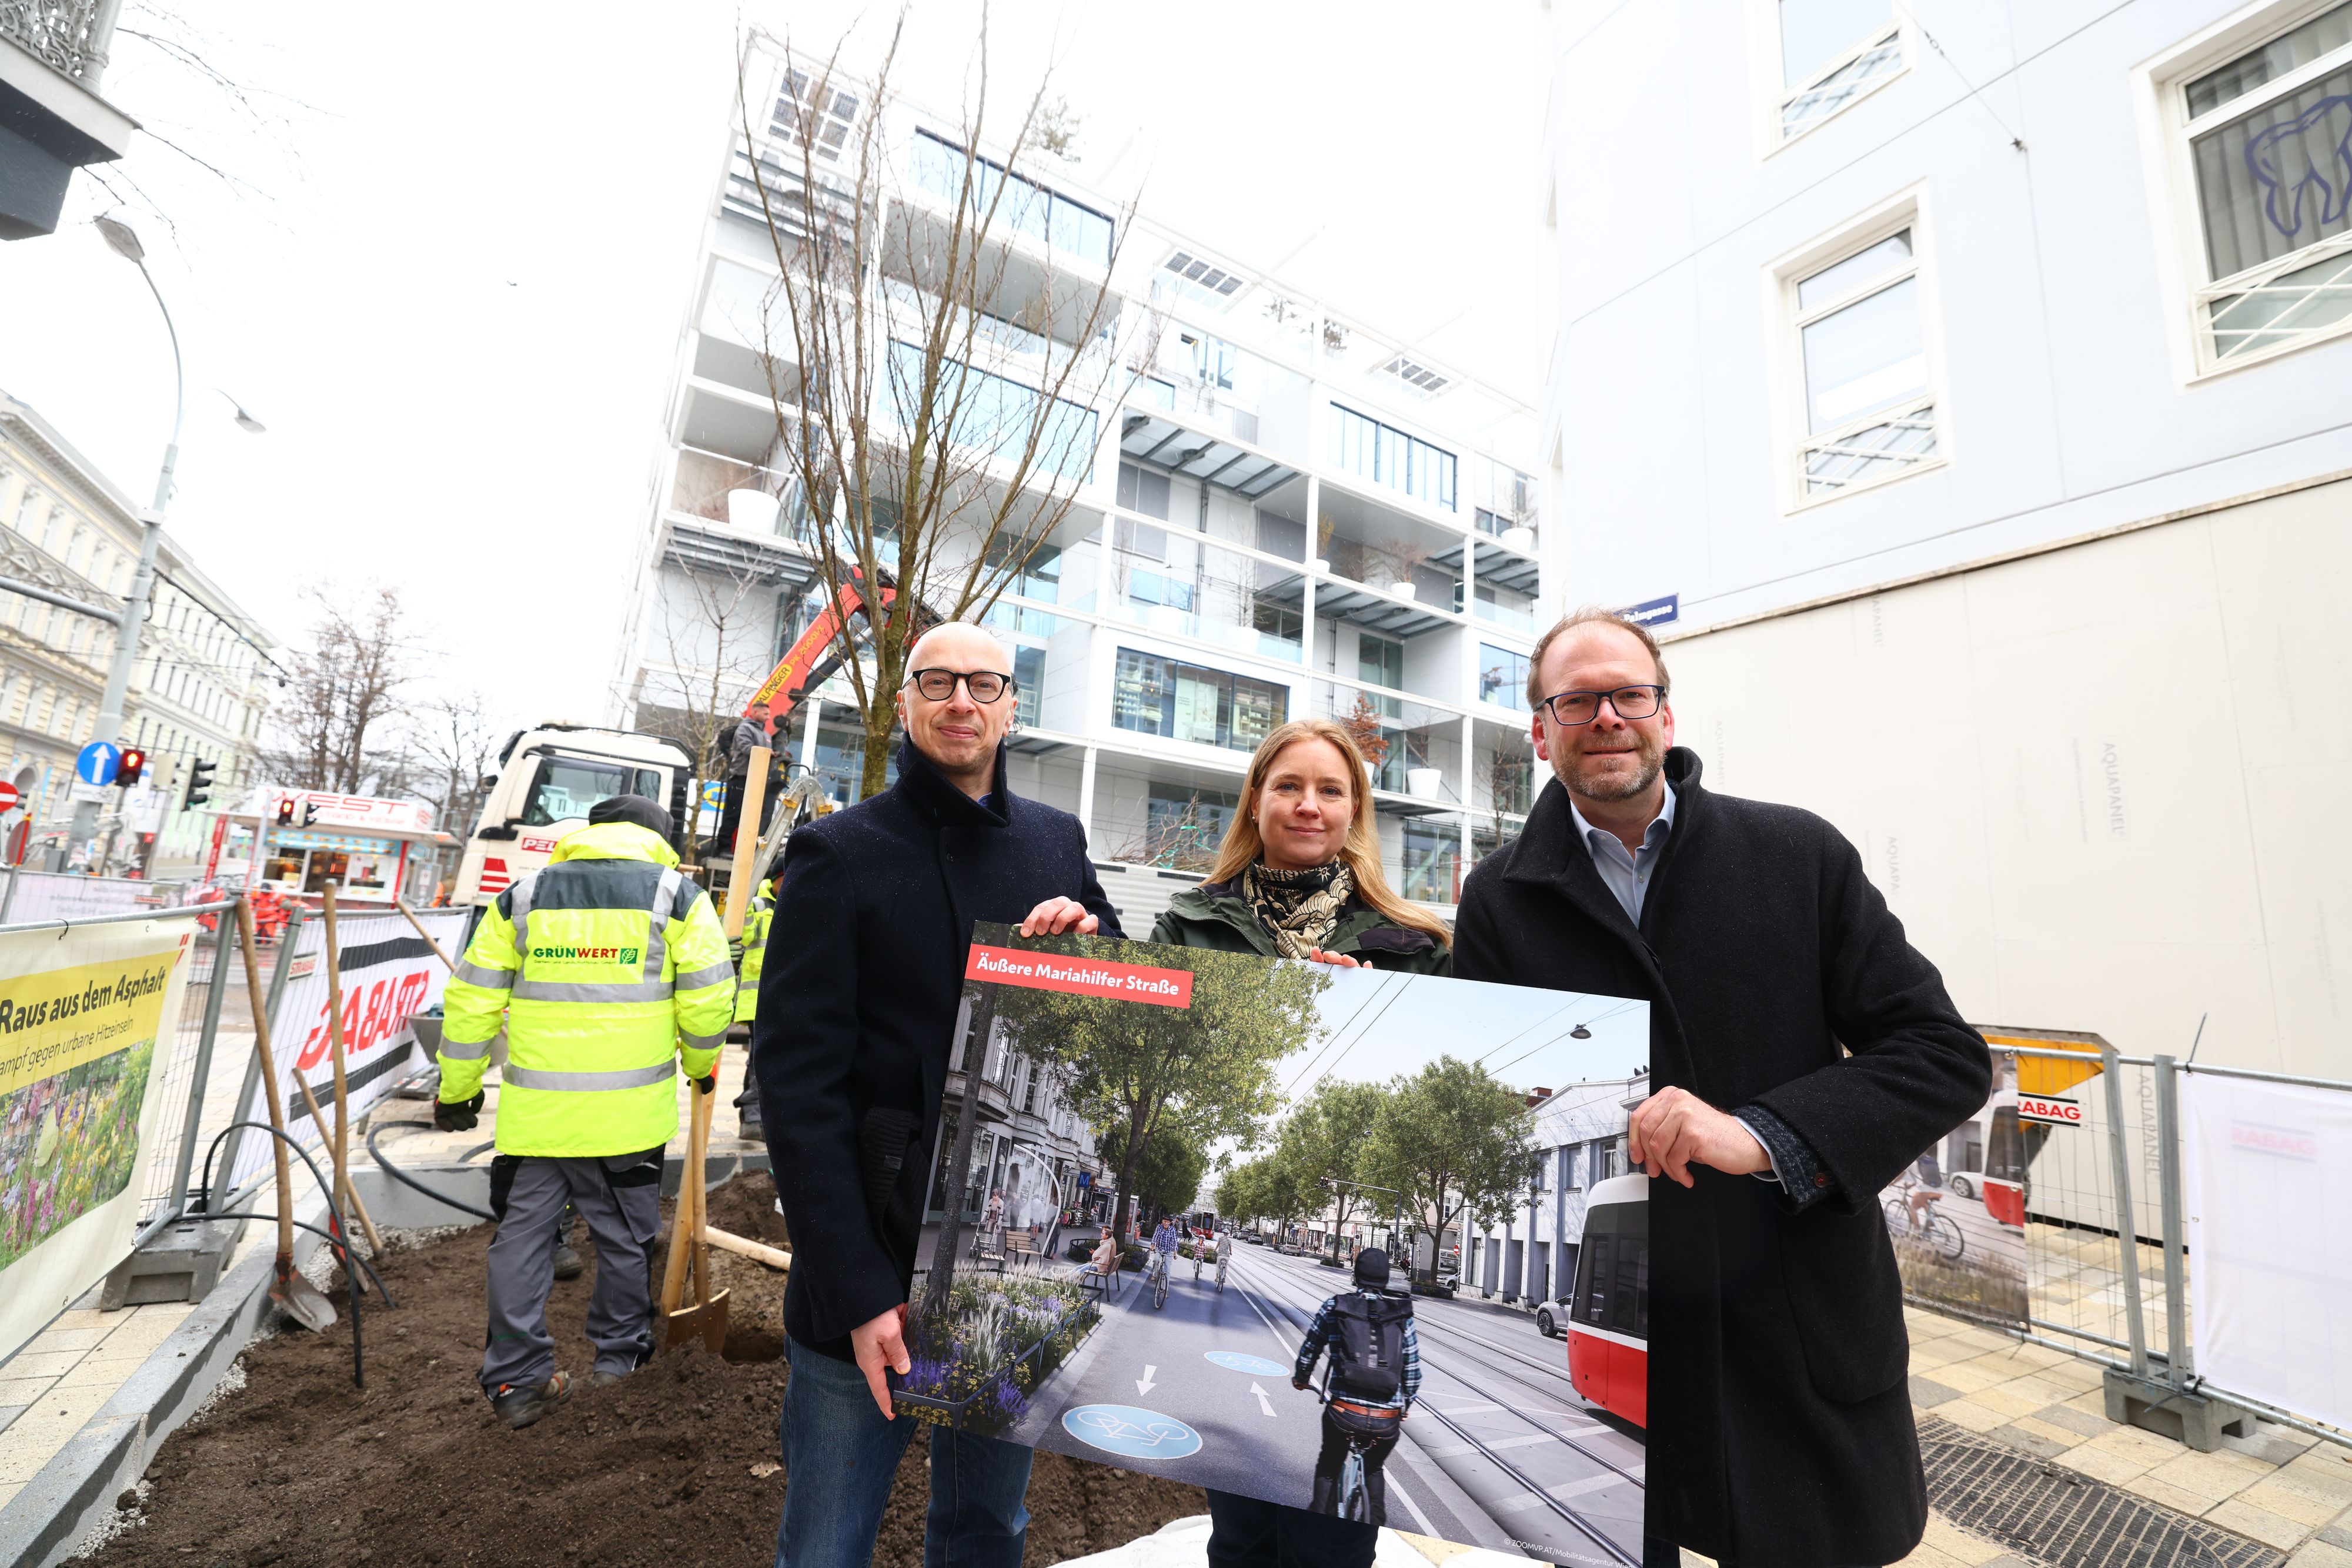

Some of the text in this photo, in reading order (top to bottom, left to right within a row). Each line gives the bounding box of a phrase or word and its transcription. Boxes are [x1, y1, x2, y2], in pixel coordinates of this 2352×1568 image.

[1623, 605, 1673, 622] Palmgasse
[759, 667, 790, 704] ALFINGER
[790, 654, 800, 666] PK
[534, 945, 617, 958] GRÜNWERT
[977, 952, 1179, 995] Äußere Mariahilfer Straße
[0, 966, 166, 1035] Raus aus dem Asphalt
[28, 1042, 61, 1072] gegen
[62, 1032, 95, 1054] urbane
[95, 1014, 133, 1043] Hitzeinseln
[1512, 1539, 1613, 1566] ZOOMVP.AT/Mobilitätsagentur
